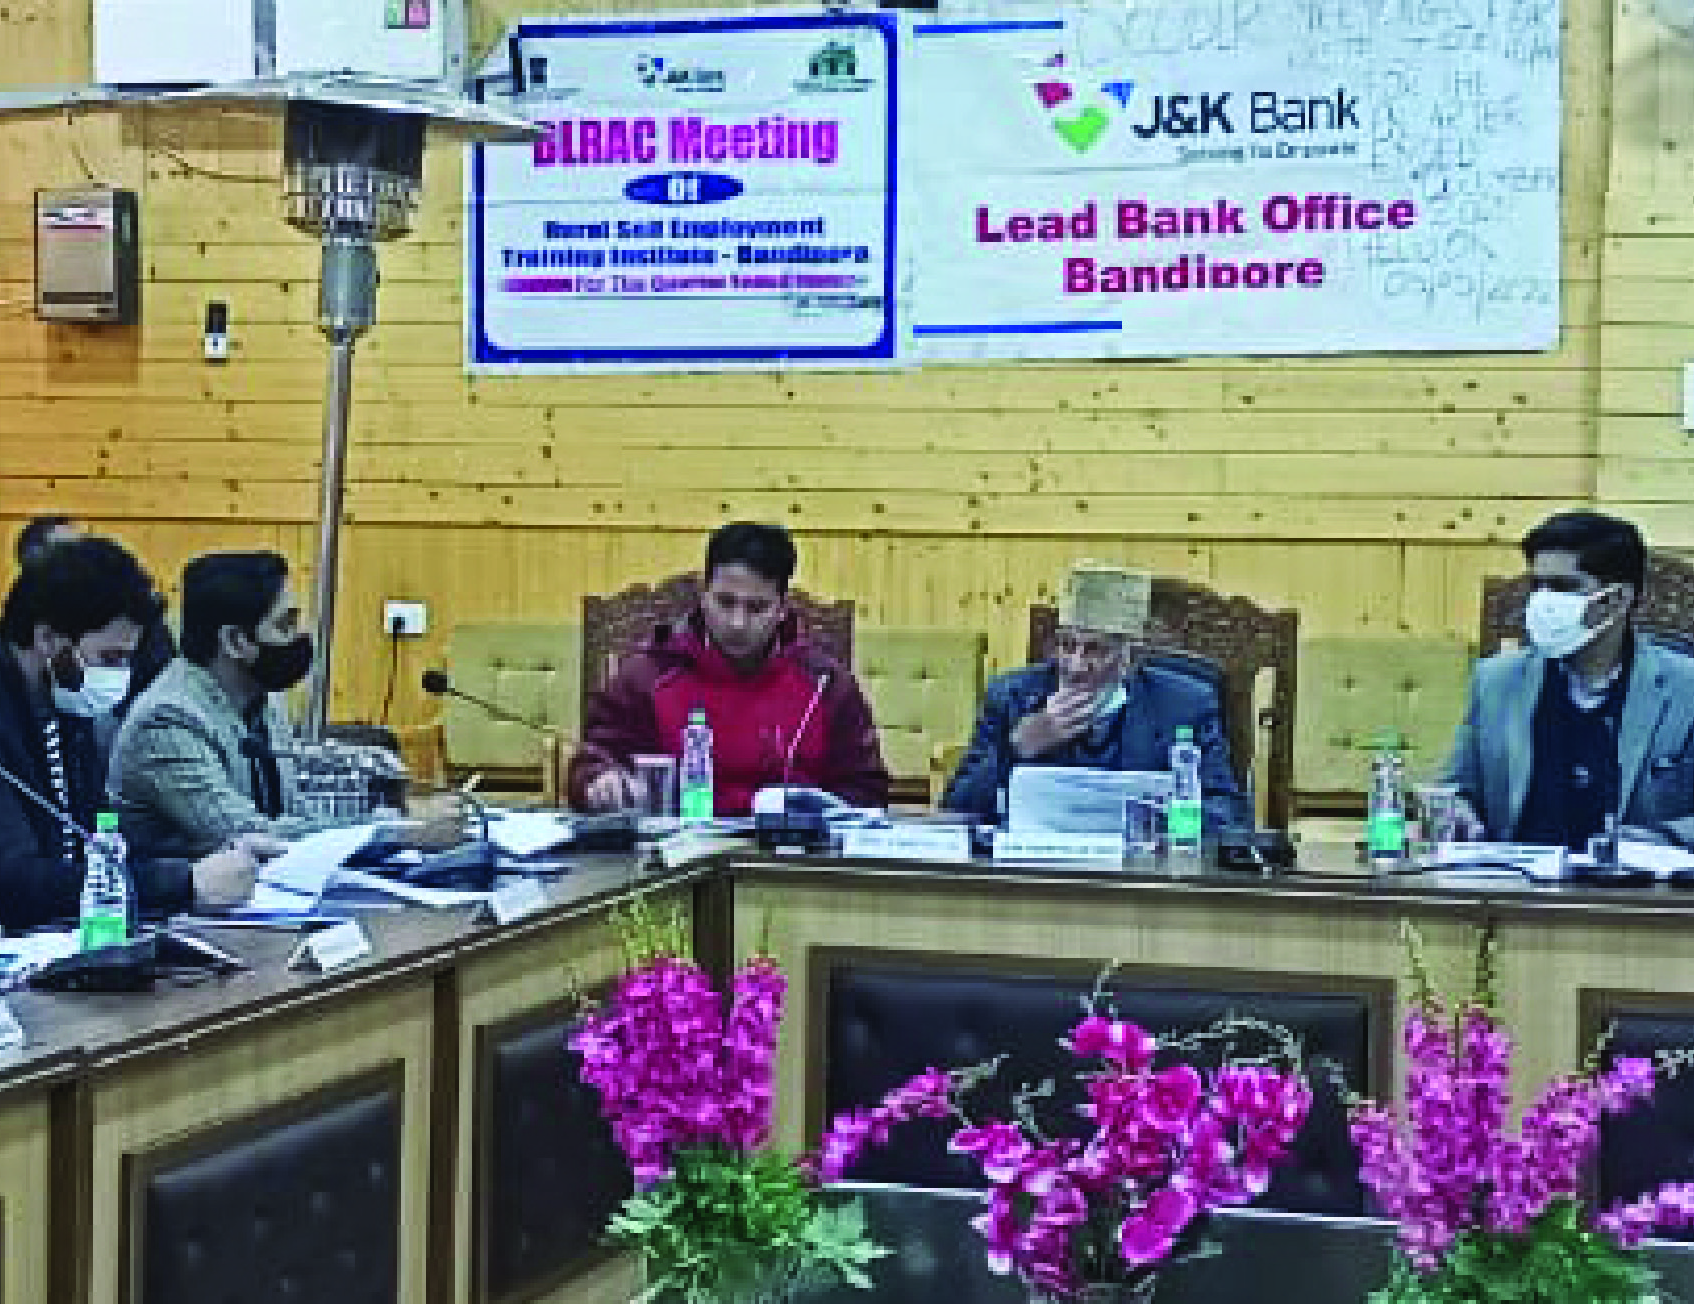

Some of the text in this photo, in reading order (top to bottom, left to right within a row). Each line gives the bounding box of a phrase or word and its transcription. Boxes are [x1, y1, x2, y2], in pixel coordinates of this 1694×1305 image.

[1131, 92, 1233, 138] J&K
[1250, 87, 1359, 133] Bank
[667, 115, 839, 166] Meeting
[975, 202, 1097, 242] Lead
[1117, 198, 1245, 239] Bank
[1263, 194, 1416, 234] Office
[500, 246, 605, 270] Training
